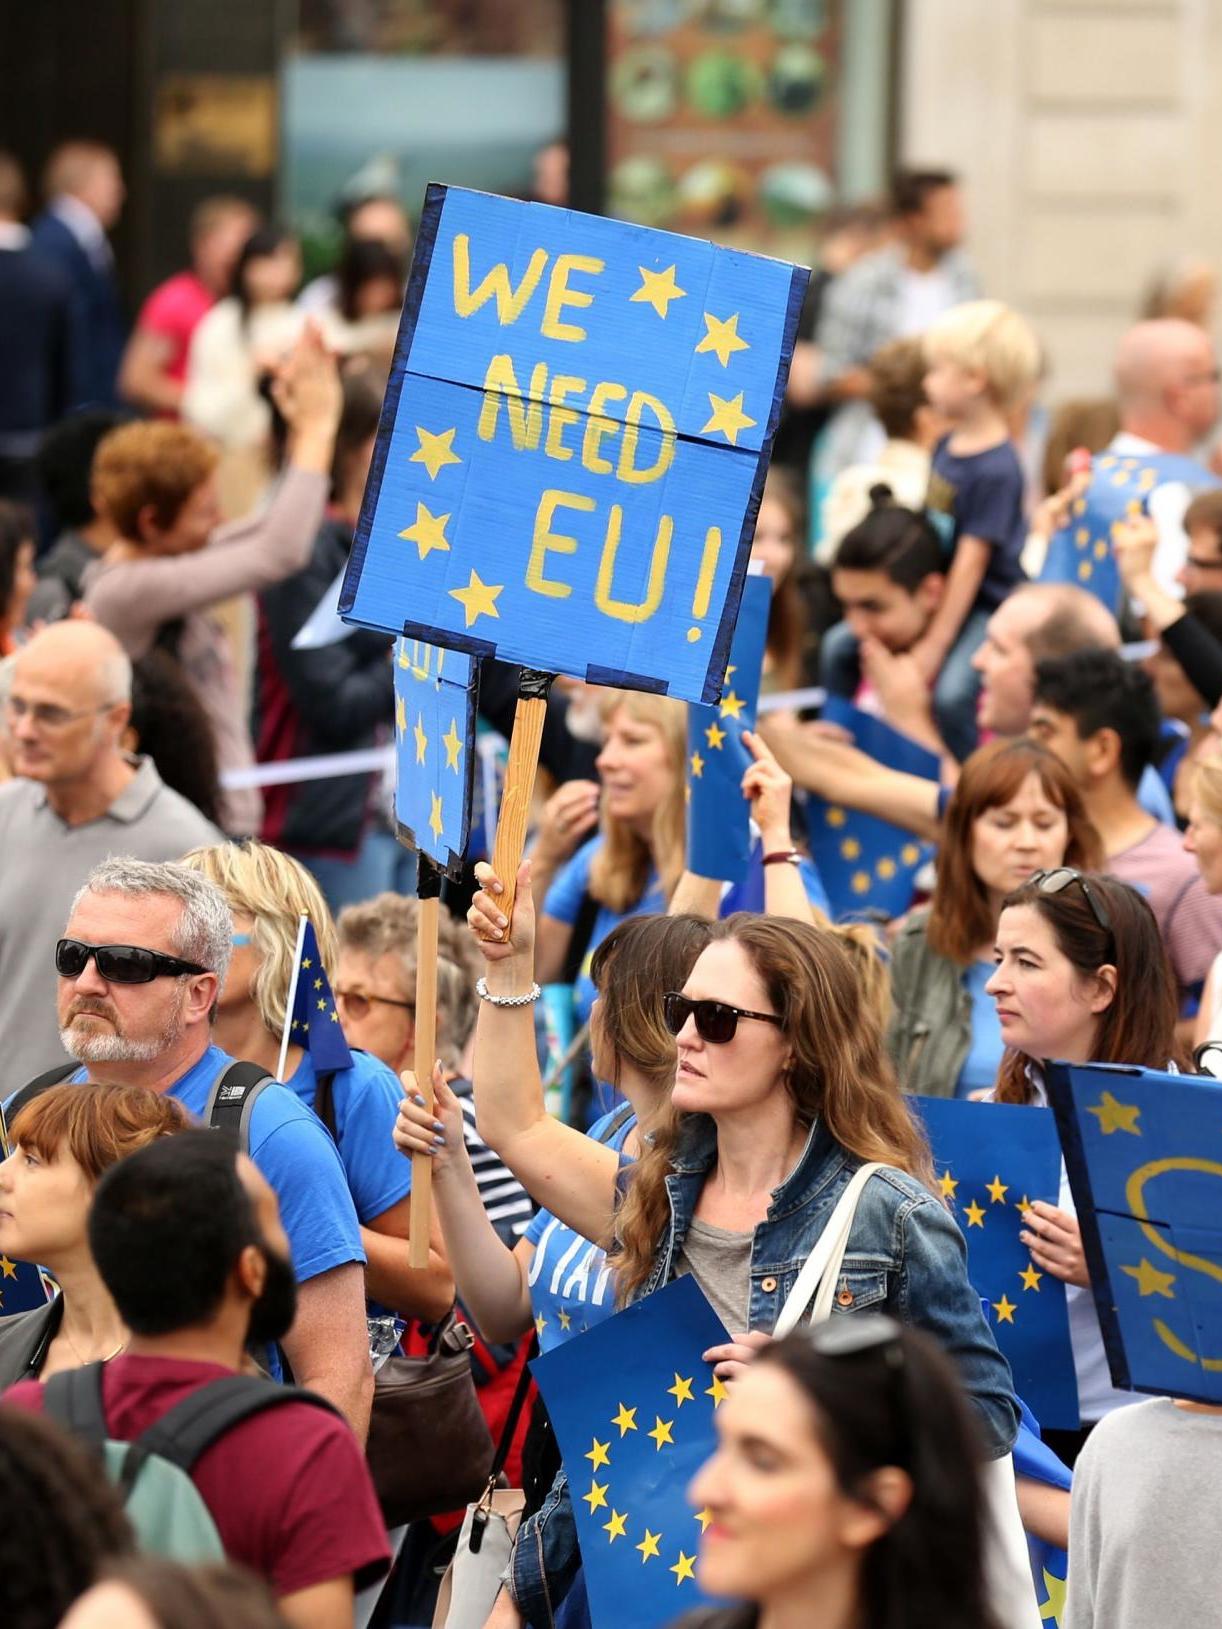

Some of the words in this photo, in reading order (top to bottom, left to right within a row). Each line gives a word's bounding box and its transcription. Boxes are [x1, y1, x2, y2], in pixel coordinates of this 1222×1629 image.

[453, 233, 605, 342] WE
[477, 354, 678, 484] NEED
[525, 489, 722, 643] EU!
